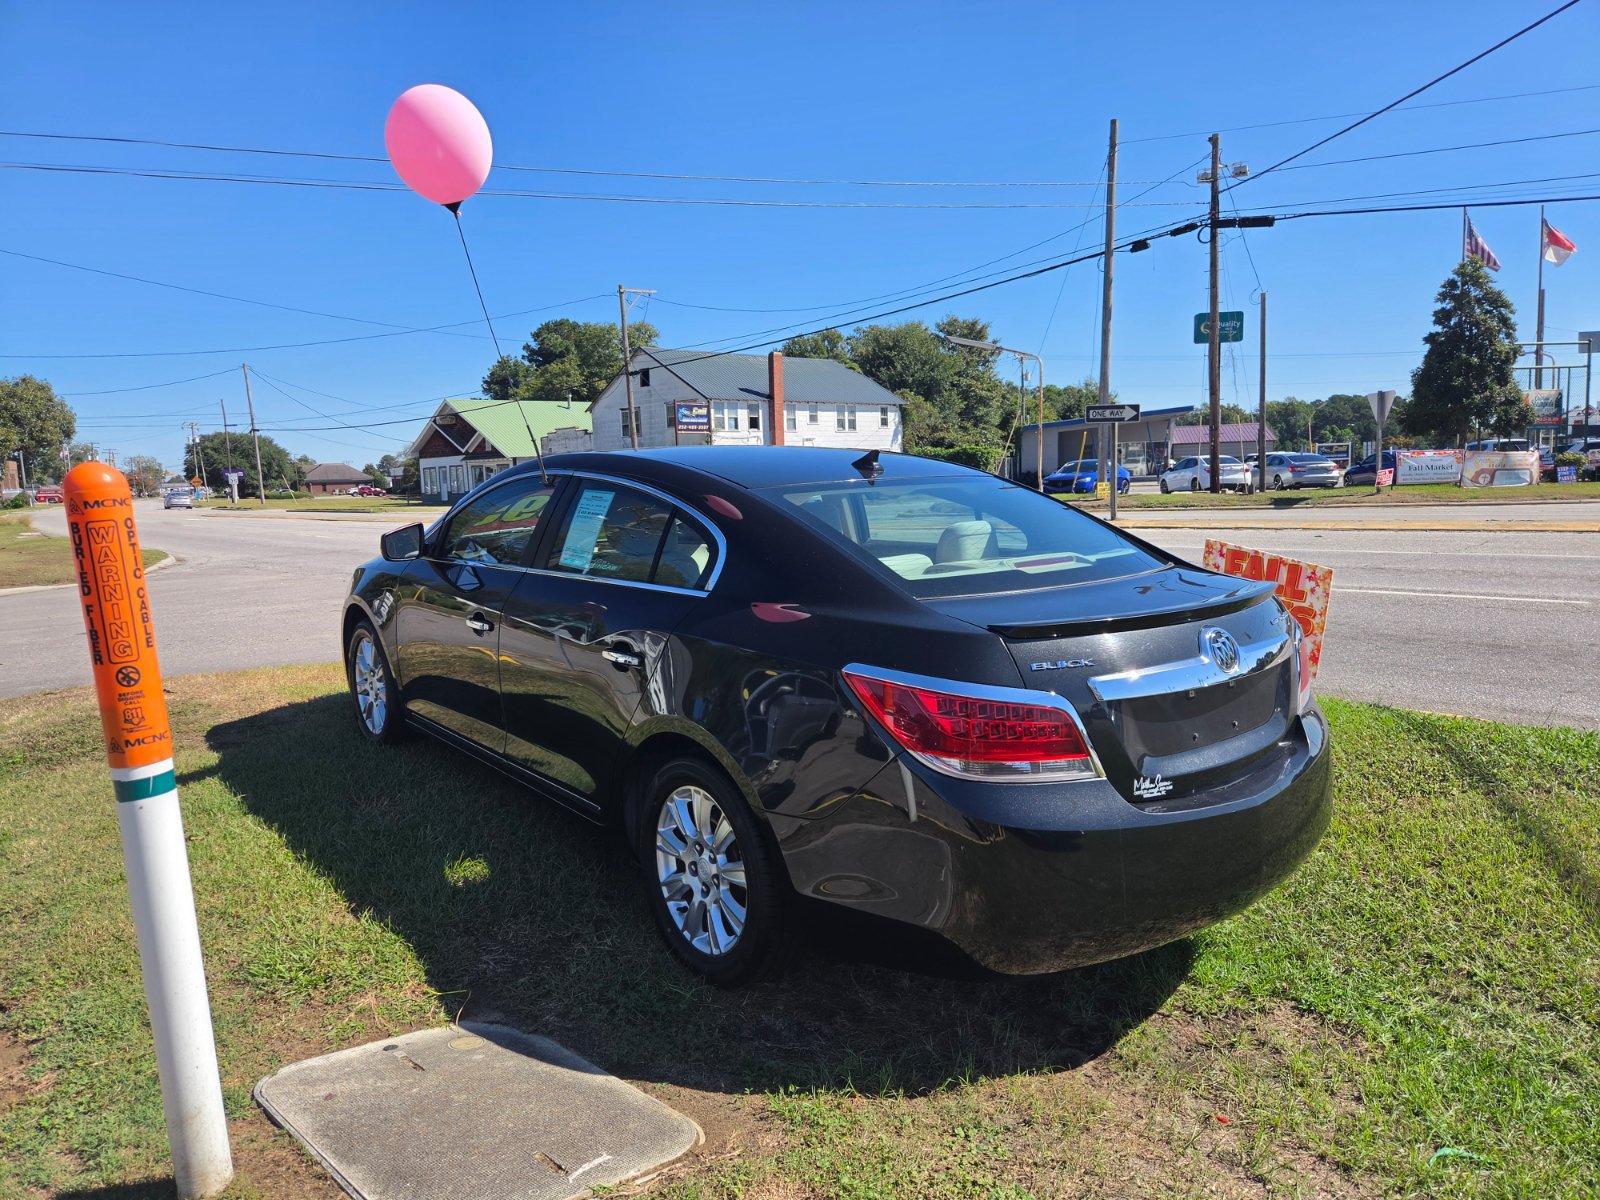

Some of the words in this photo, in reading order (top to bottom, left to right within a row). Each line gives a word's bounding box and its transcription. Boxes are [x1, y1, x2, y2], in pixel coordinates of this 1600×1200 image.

[1091, 410, 1106, 418] ONE
[83, 497, 131, 510] MCNC
[124, 517, 142, 580] OPTIC
[136, 587, 154, 648] CABLE
[1224, 548, 1308, 603] FALL
[71, 522, 92, 596] BURIED
[85, 604, 104, 665] FIBER
[89, 525, 134, 659] WARNING
[1029, 658, 1096, 671] BUICK
[123, 707, 143, 719] 811
[124, 730, 169, 748] MCNC
